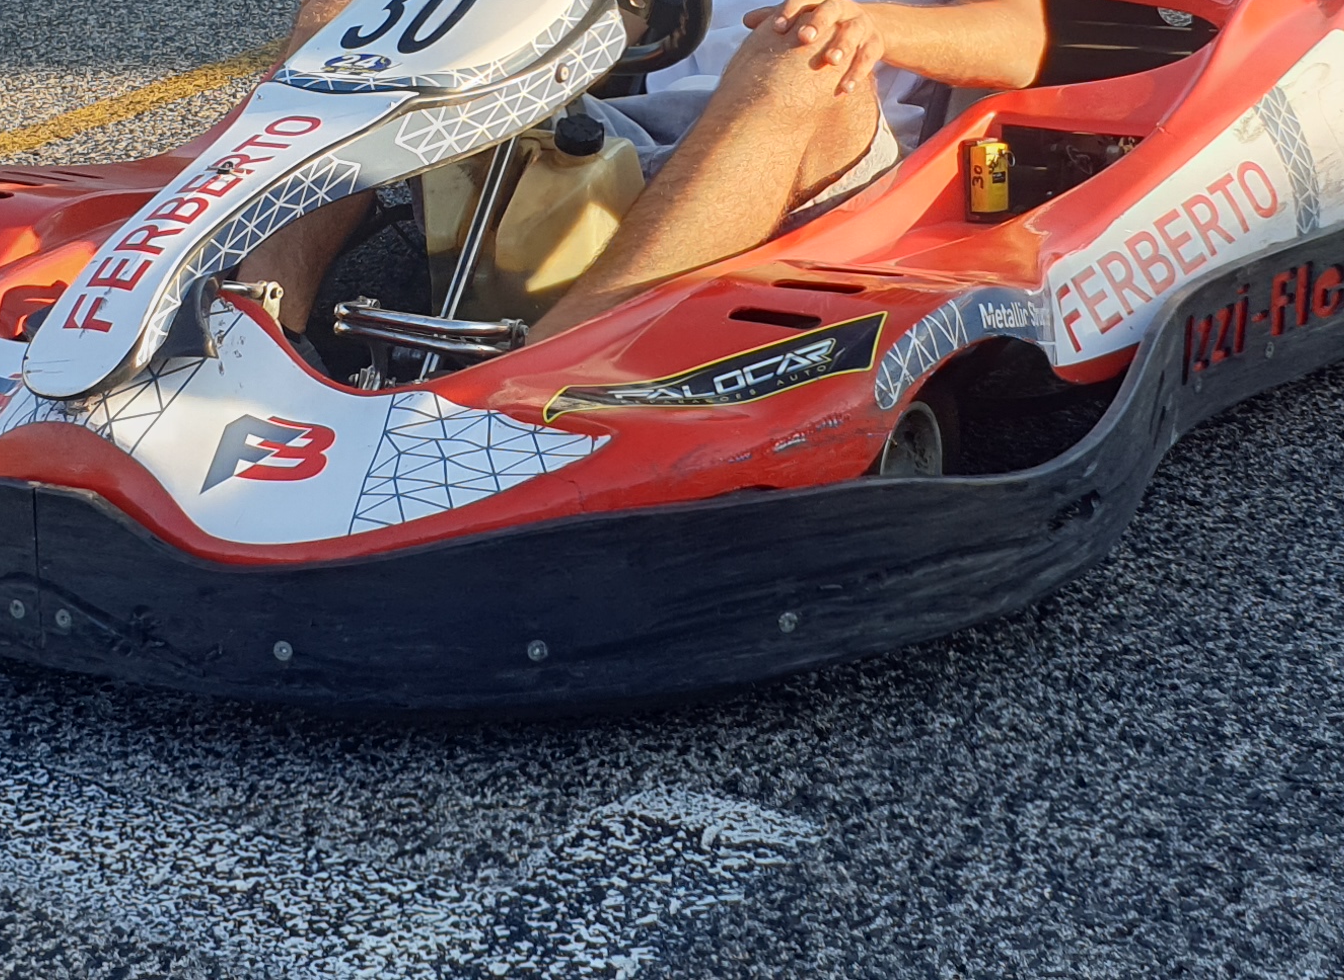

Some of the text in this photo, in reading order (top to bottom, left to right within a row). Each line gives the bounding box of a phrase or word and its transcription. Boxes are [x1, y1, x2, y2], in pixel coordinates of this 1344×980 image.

[329, 53, 382, 69] 24
[972, 164, 984, 190] 30
[62, 115, 322, 333] FERBERTO
[1055, 160, 1279, 354] FERBERTO
[978, 301, 1029, 329] Metallic
[776, 364, 828, 387] AUTO
